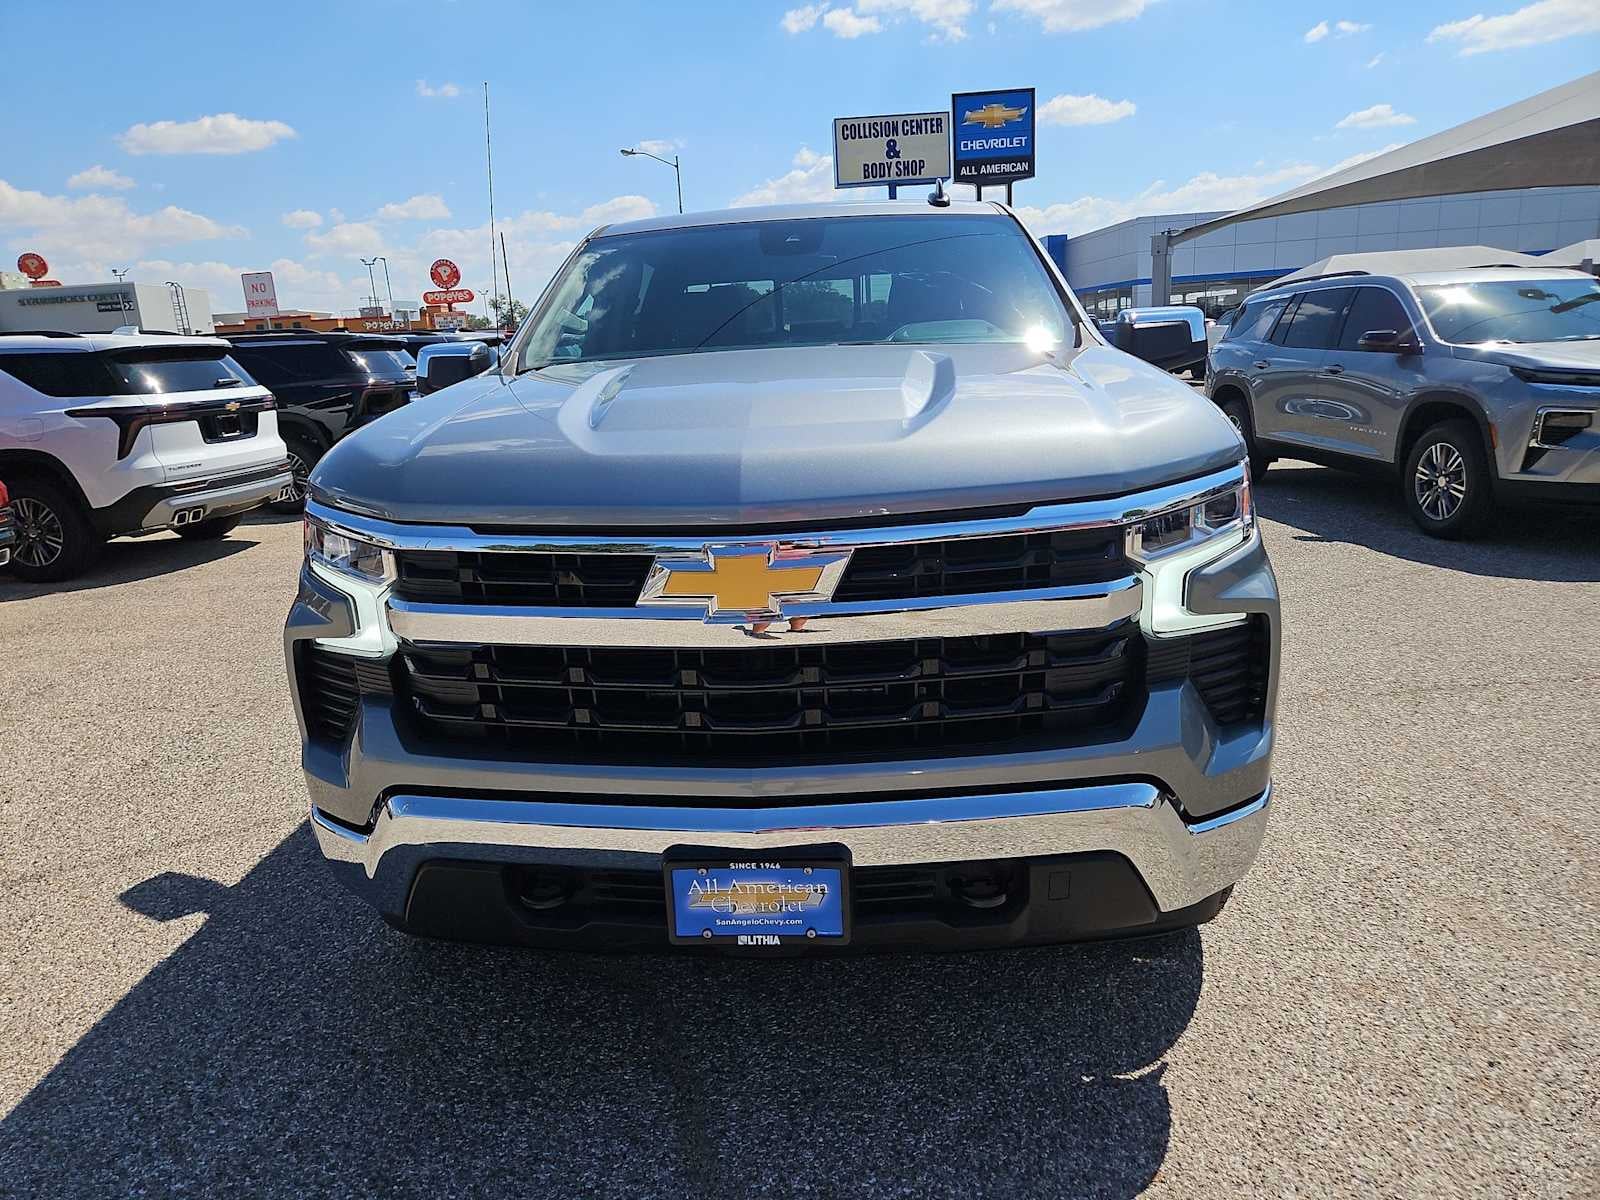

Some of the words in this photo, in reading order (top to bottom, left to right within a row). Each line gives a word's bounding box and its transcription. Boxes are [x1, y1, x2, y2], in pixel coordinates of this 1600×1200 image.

[841, 120, 899, 140] COLLISION
[901, 117, 943, 136] CENTER
[885, 138, 901, 160] &
[960, 136, 1027, 151] CHEVROLET
[863, 162, 892, 180] BODY
[895, 159, 925, 177] SHOP
[960, 165, 978, 176] ALL
[980, 162, 1029, 174] AMERICAN
[251, 282, 266, 293] NO
[247, 298, 277, 308] PARKING
[729, 862, 757, 870] SINCE
[759, 862, 781, 870] 1946
[687, 878, 719, 895] All
[727, 878, 829, 895] American
[711, 896, 806, 914] Chevrolet
[715, 918, 803, 927] SanAngeloChevy.com
[746, 935, 781, 946] LITHIA
